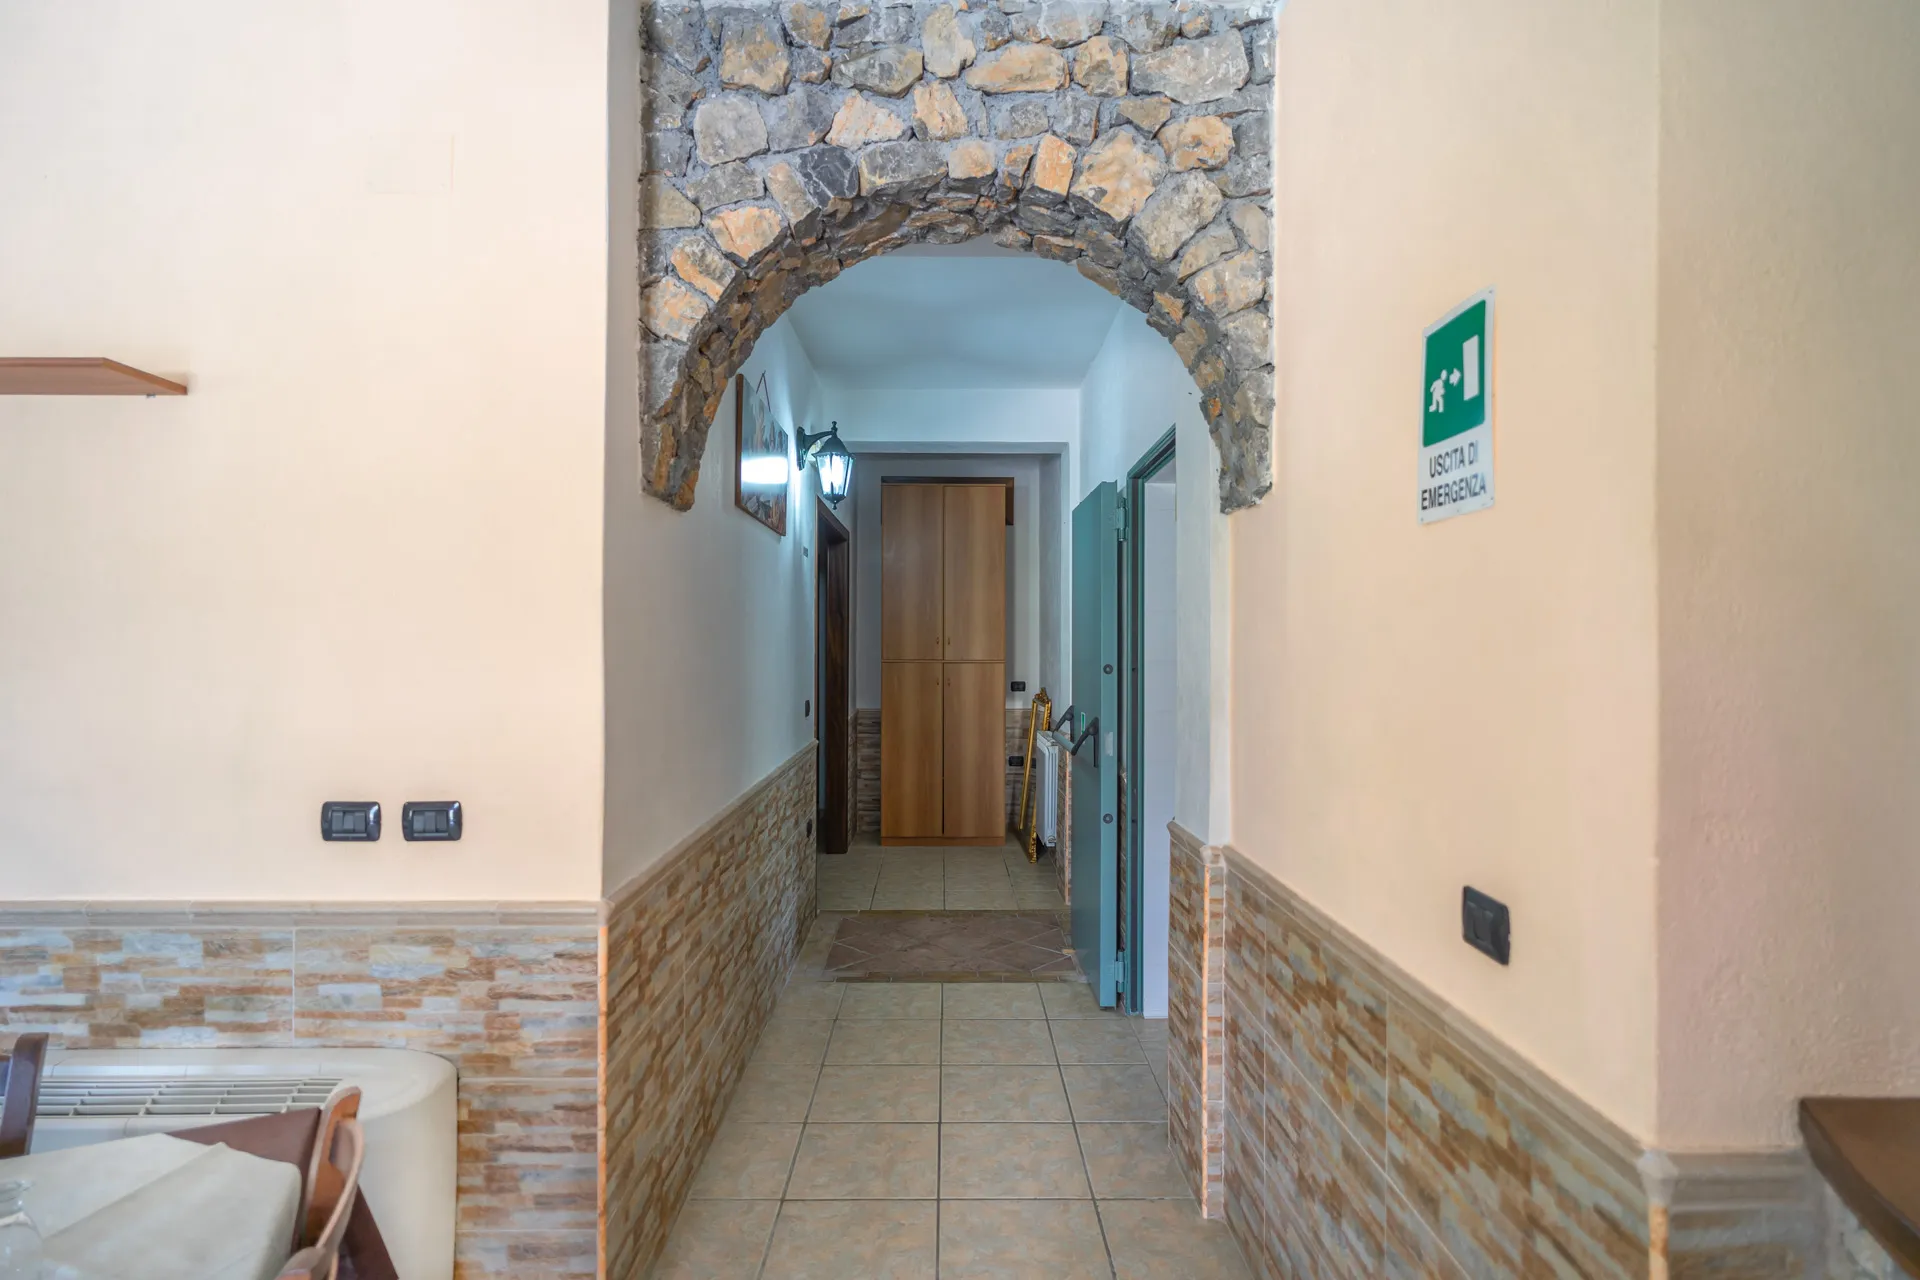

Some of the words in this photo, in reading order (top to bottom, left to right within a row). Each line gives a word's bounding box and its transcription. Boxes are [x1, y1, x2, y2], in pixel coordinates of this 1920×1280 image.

[1429, 445, 1466, 478] USCITA
[1468, 439, 1479, 466] DI
[1421, 472, 1487, 511] EMERGENZA
